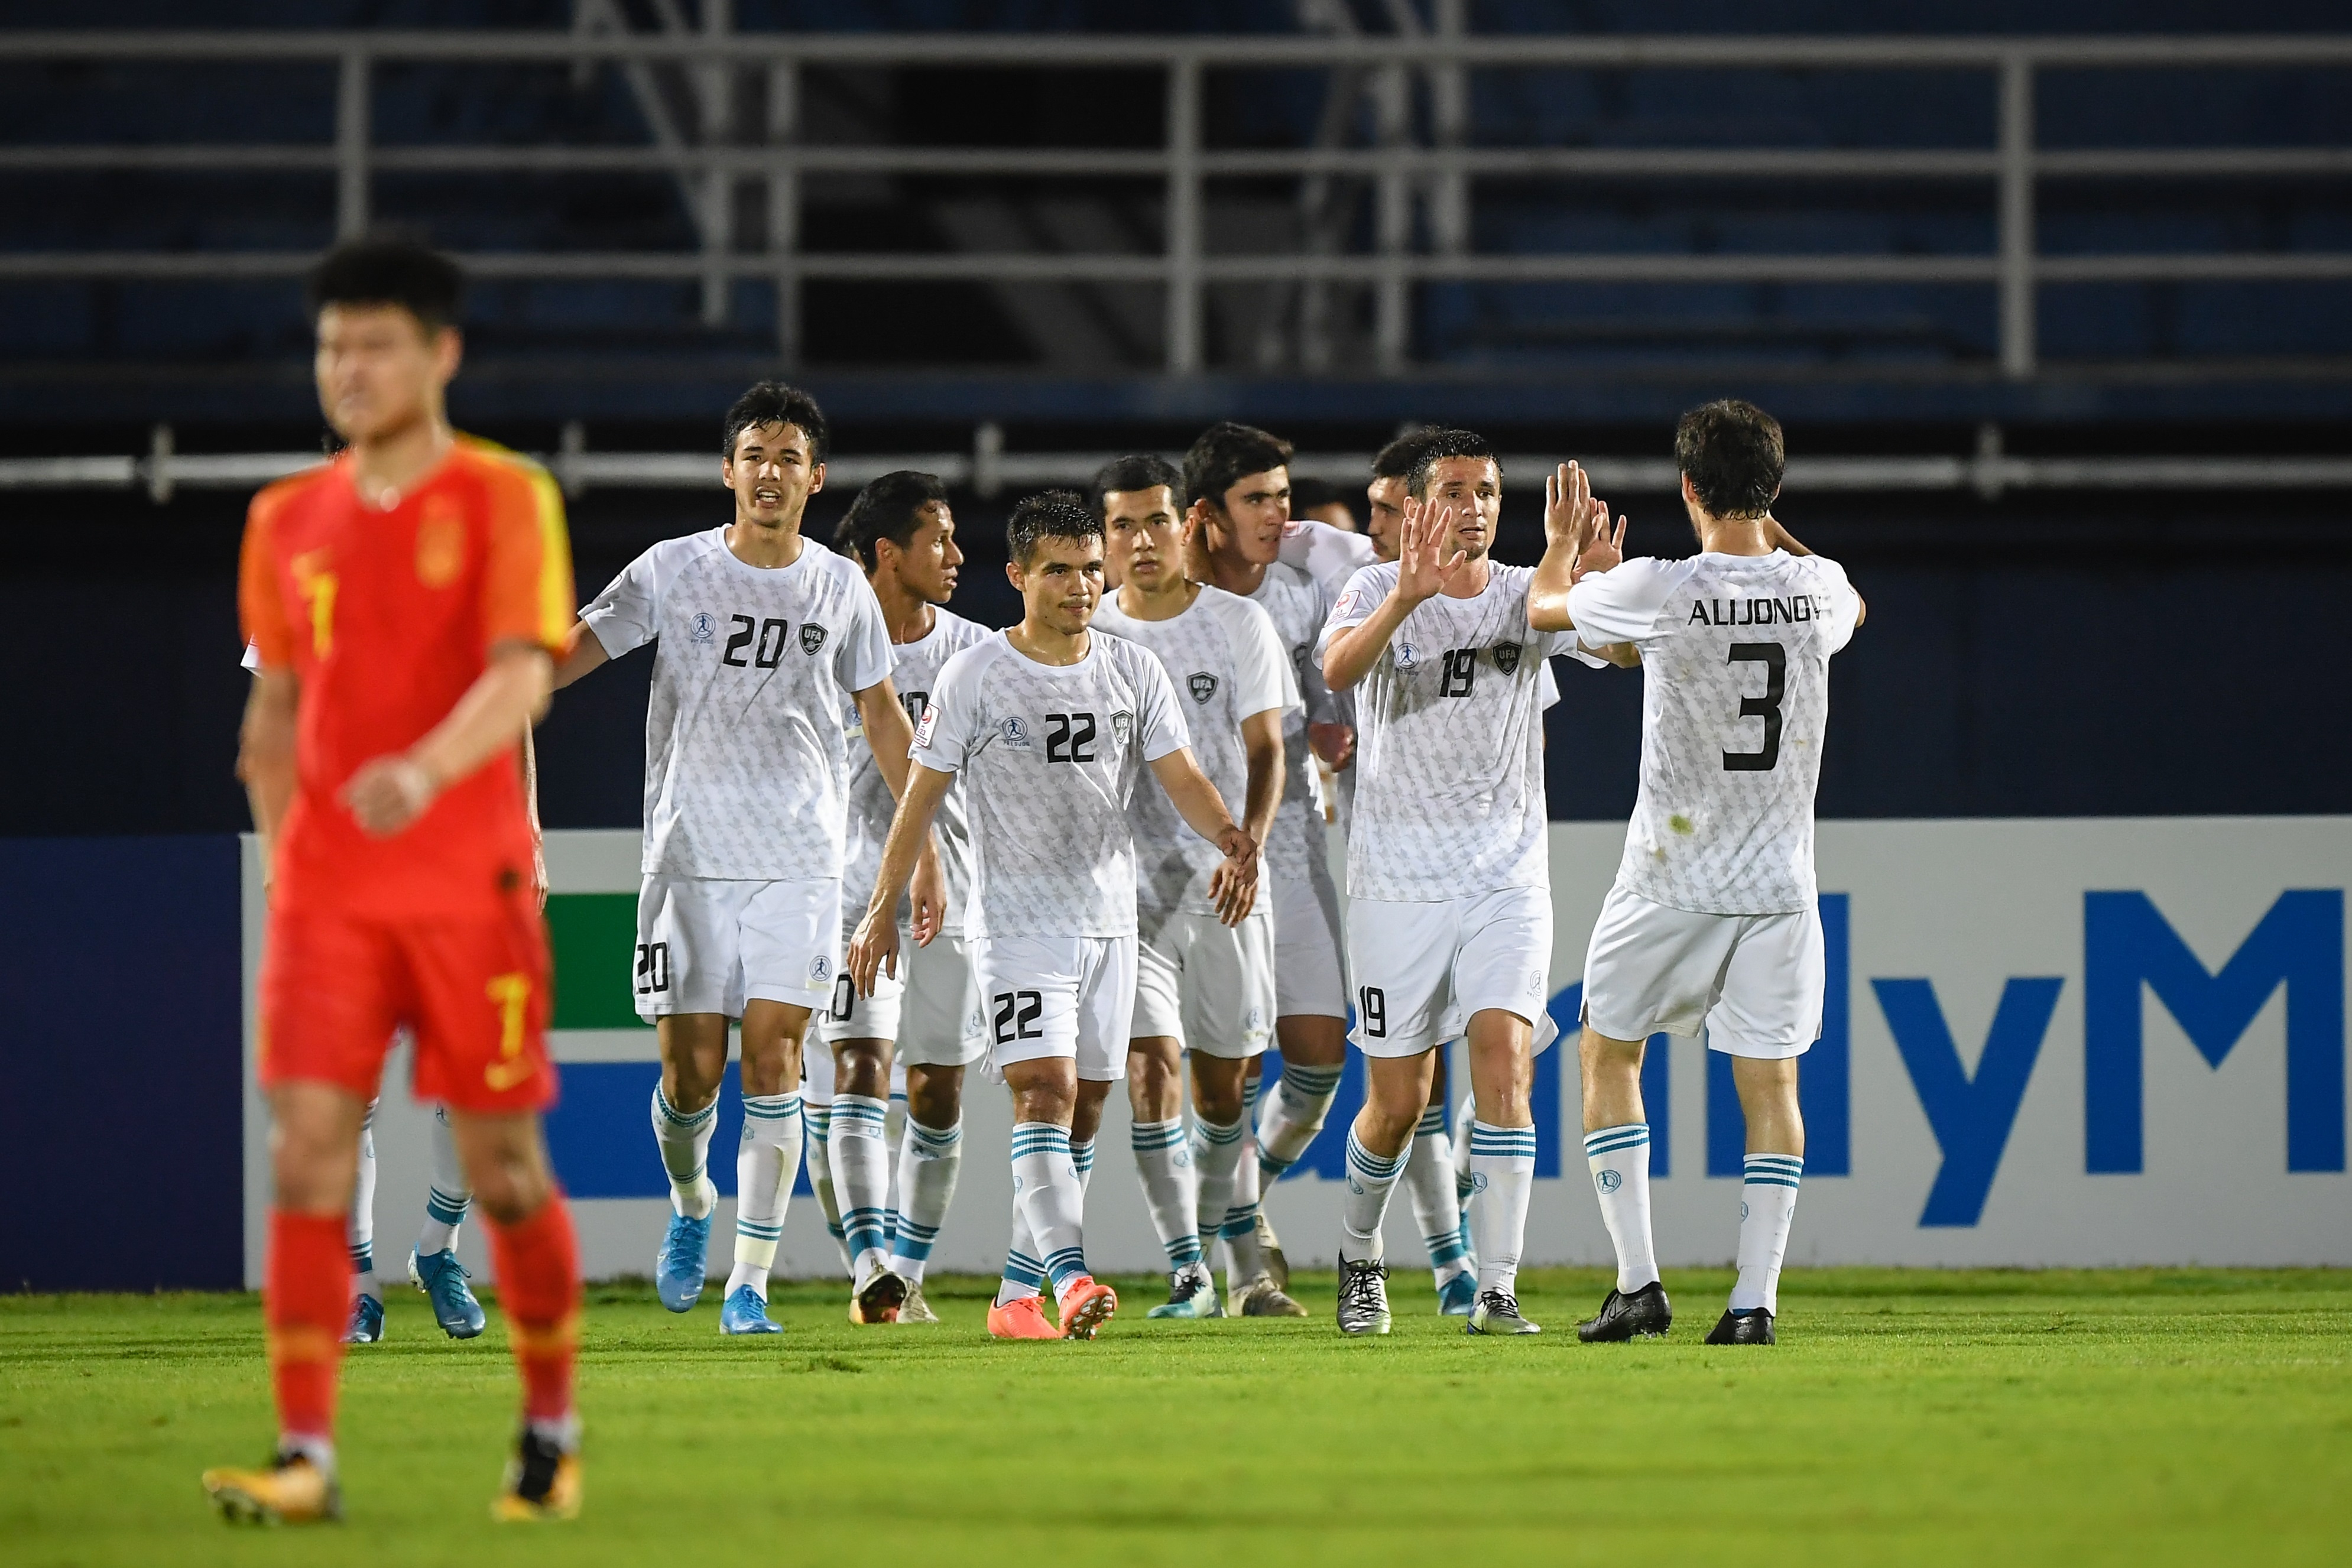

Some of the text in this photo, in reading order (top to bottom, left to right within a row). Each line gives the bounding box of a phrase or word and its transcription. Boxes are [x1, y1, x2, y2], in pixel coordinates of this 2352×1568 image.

[803, 628, 822, 642] UFA
[1687, 595, 1821, 626] ALIJONOV
[722, 613, 788, 669] 20
[1499, 649, 1516, 660] UFA
[1192, 679, 1212, 690] UFA
[1439, 648, 1477, 698] 19
[1115, 718, 1128, 728] UFA
[1722, 642, 1787, 771] 3
[1045, 712, 1096, 763] 22
[636, 942, 669, 995] 20
[825, 973, 855, 1023] 0
[994, 991, 1043, 1046] 22
[1360, 985, 1387, 1038] 19
